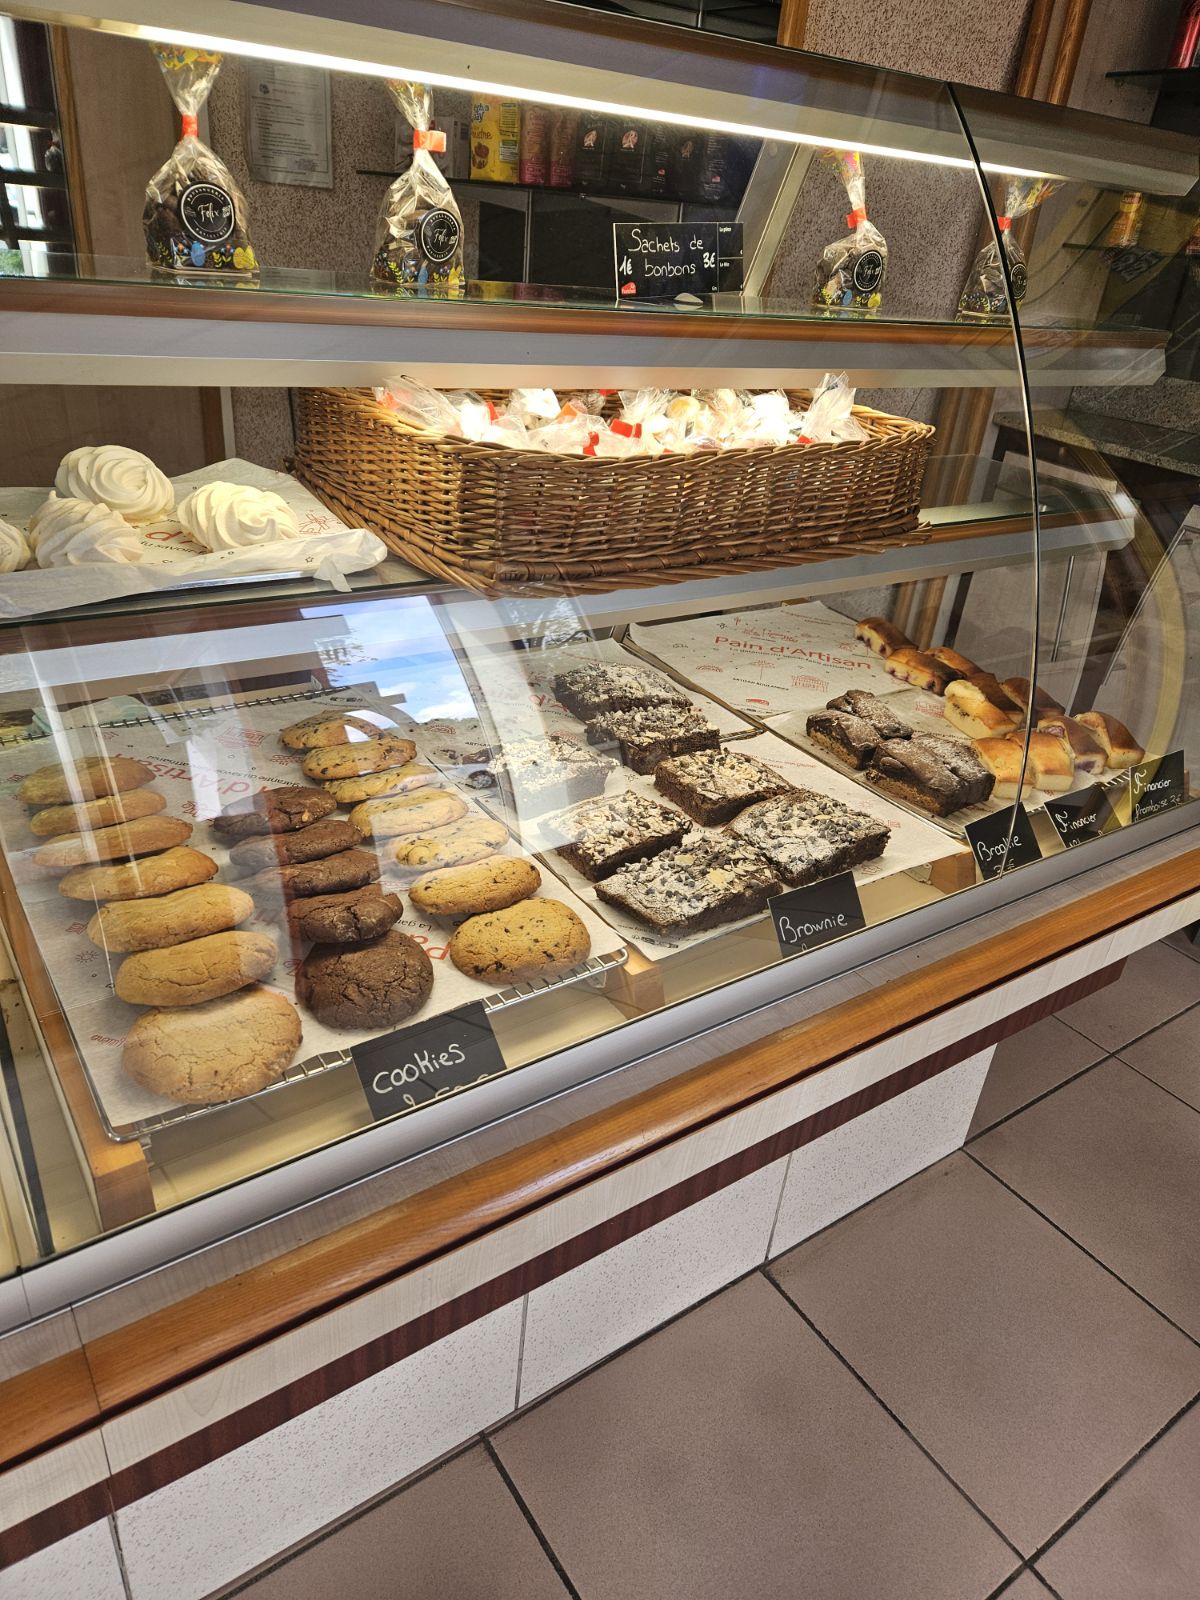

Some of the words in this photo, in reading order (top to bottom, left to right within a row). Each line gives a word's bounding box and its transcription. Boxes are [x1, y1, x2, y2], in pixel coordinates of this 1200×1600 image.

[628, 228, 680, 253] Sachets
[689, 233, 704, 250] de
[619, 255, 633, 276] 1€
[644, 257, 697, 277] bonbons
[702, 251, 716, 268] 3€
[714, 635, 763, 652] Pain
[769, 645, 872, 670] d'Artisan
[779, 913, 848, 943] Brownie
